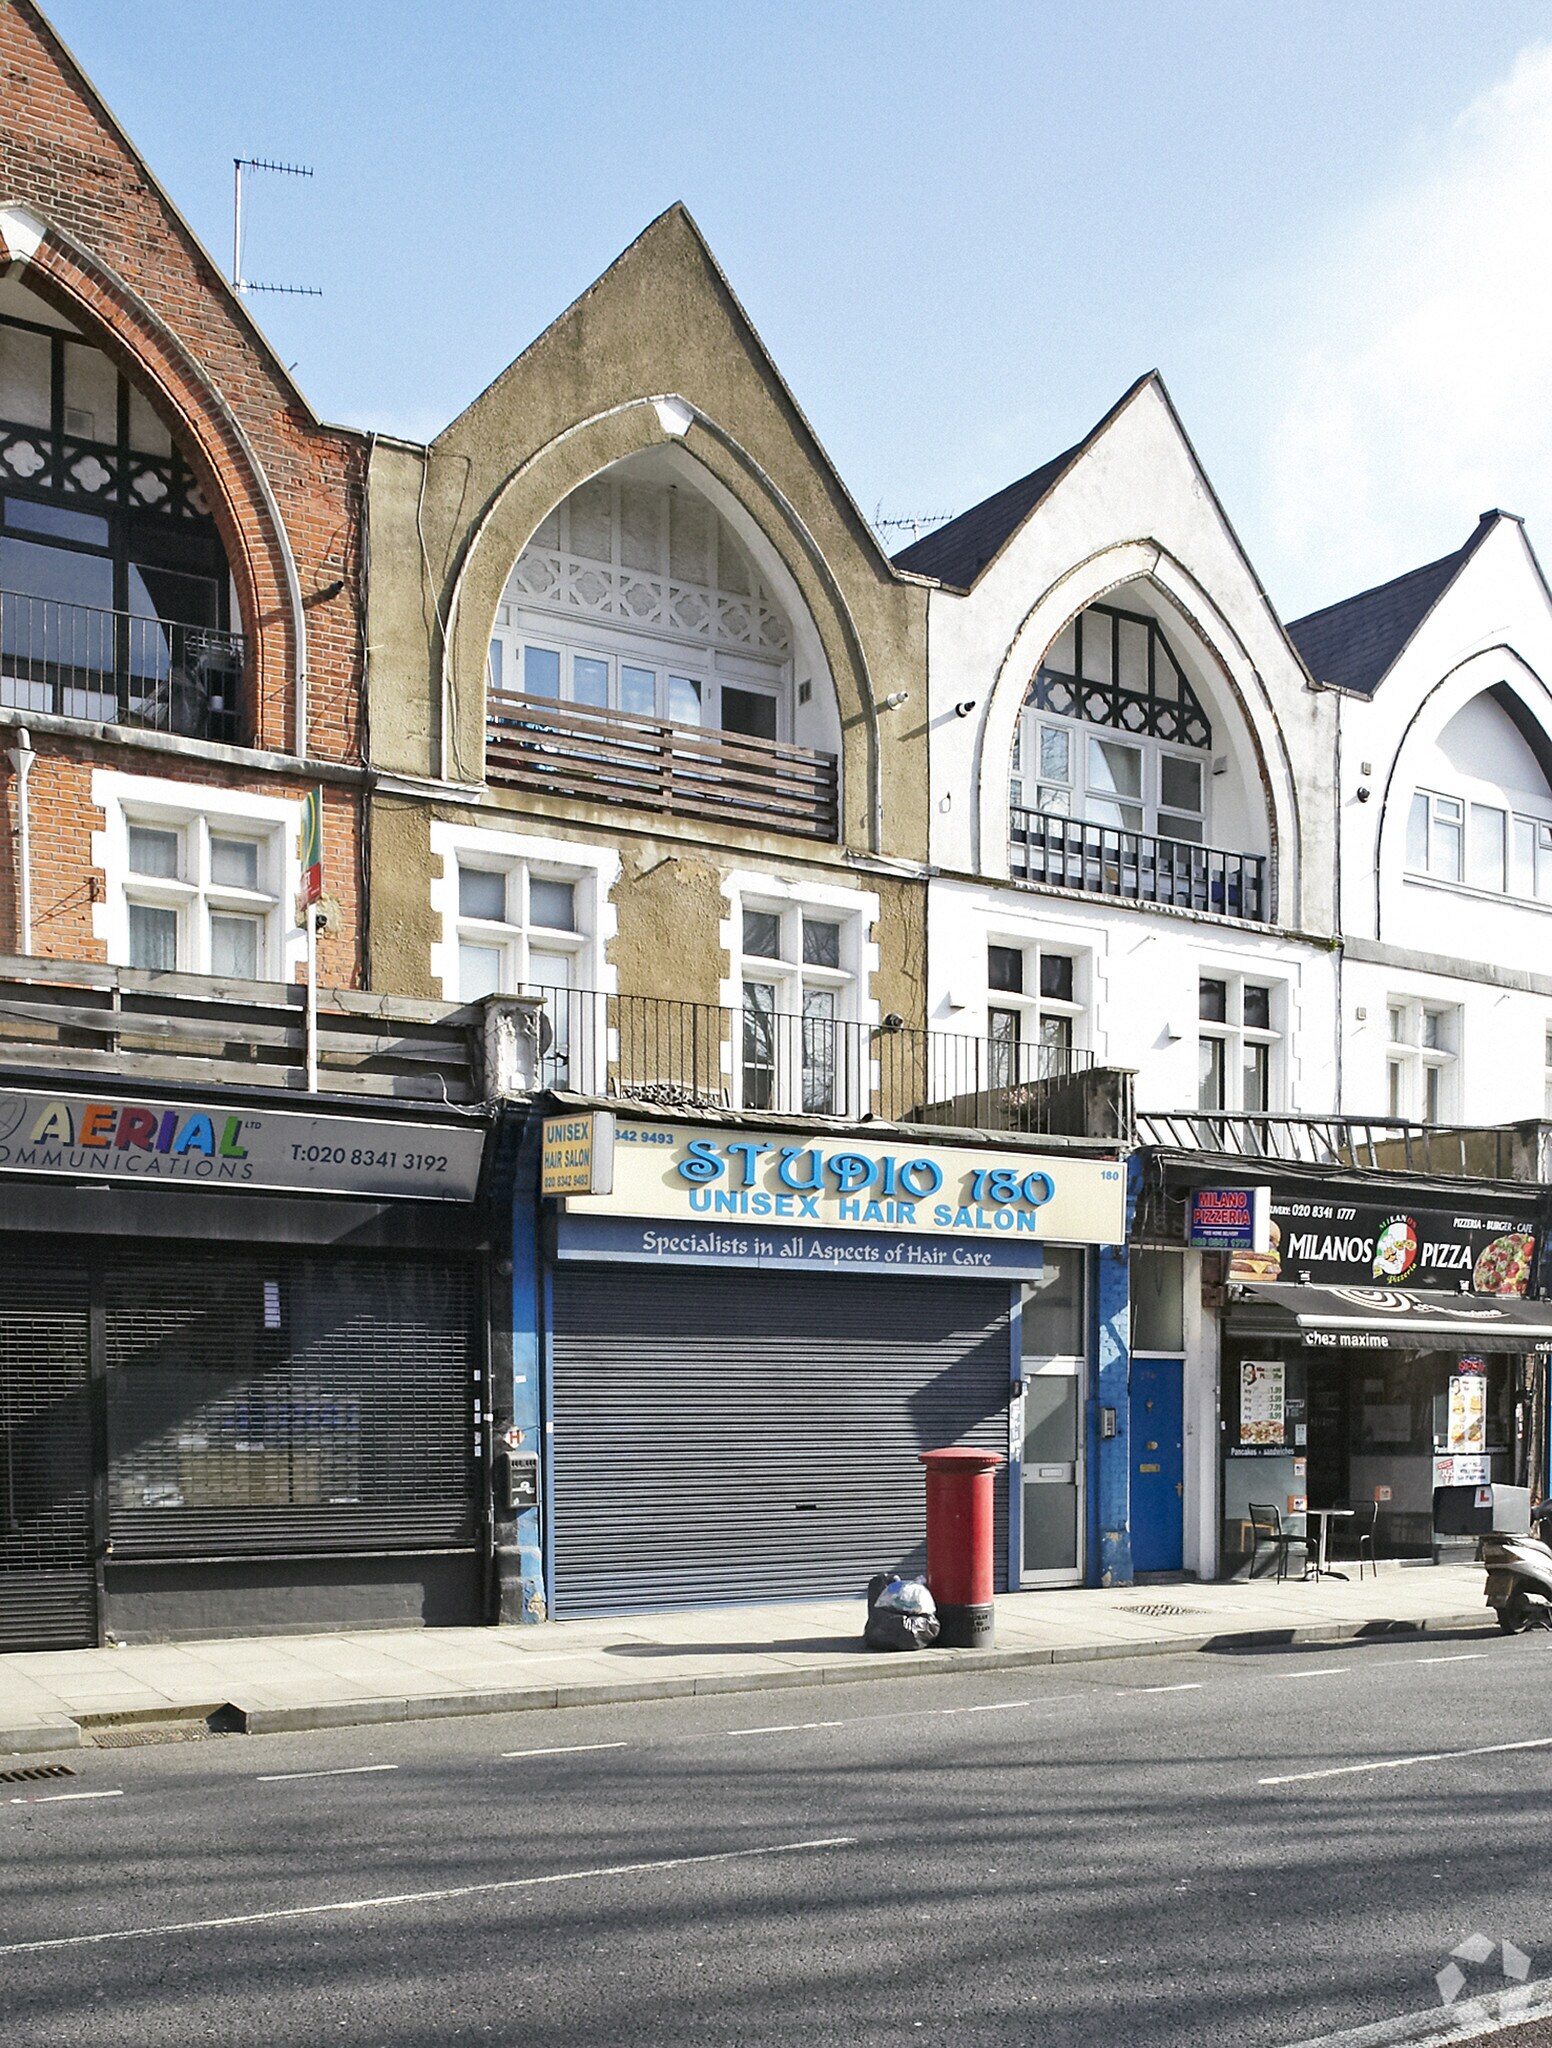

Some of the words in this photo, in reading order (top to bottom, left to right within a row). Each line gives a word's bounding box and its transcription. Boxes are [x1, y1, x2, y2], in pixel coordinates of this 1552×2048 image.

[30, 1103, 248, 1159] AERIAL
[245, 1121, 262, 1130] LTD
[546, 1122, 589, 1143] UNISEX
[640, 1131, 674, 1144] 9493
[291, 1144, 345, 1164] T:020
[351, 1149, 396, 1168] 8341
[403, 1153, 448, 1172] 3192
[544, 1150, 562, 1168] HAIR
[565, 1147, 589, 1168] SALON
[678, 1139, 943, 1198] STUDIO
[970, 1168, 1056, 1206] 180
[1100, 1170, 1120, 1181] 180
[1198, 1192, 1247, 1208] MILANO
[688, 1187, 821, 1219] UNISEX
[838, 1198, 916, 1225] HAIR
[933, 1205, 1037, 1232] SALON
[1193, 1208, 1251, 1225] PIZZERIA
[1291, 1203, 1311, 1217] 020
[1312, 1205, 1333, 1219] 8341
[1336, 1208, 1357, 1221] 1777
[1453, 1217, 1482, 1230] PIZZERIA
[1486, 1220, 1513, 1232] BURGER
[1516, 1222, 1534, 1234] CAFE
[642, 1230, 748, 1256] Specialists
[754, 1237, 773, 1256] in
[780, 1236, 803, 1258] all
[808, 1240, 880, 1266] Aspects
[884, 1242, 905, 1263] of
[907, 1245, 947, 1264] Hair
[951, 1247, 992, 1267] Care
[1287, 1232, 1374, 1263] MILANOS
[1420, 1242, 1473, 1270] PIZZA
[1386, 1262, 1418, 1285] Pizzeria
[1305, 1332, 1337, 1346] chez
[1340, 1333, 1389, 1348] maxime
[1458, 1360, 1485, 1372] OPEN
[509, 1430, 520, 1444] H
[1231, 1447, 1257, 1456] Pancakes
[1263, 1446, 1295, 1456] sandwiches
[1480, 1490, 1490, 1502] L
